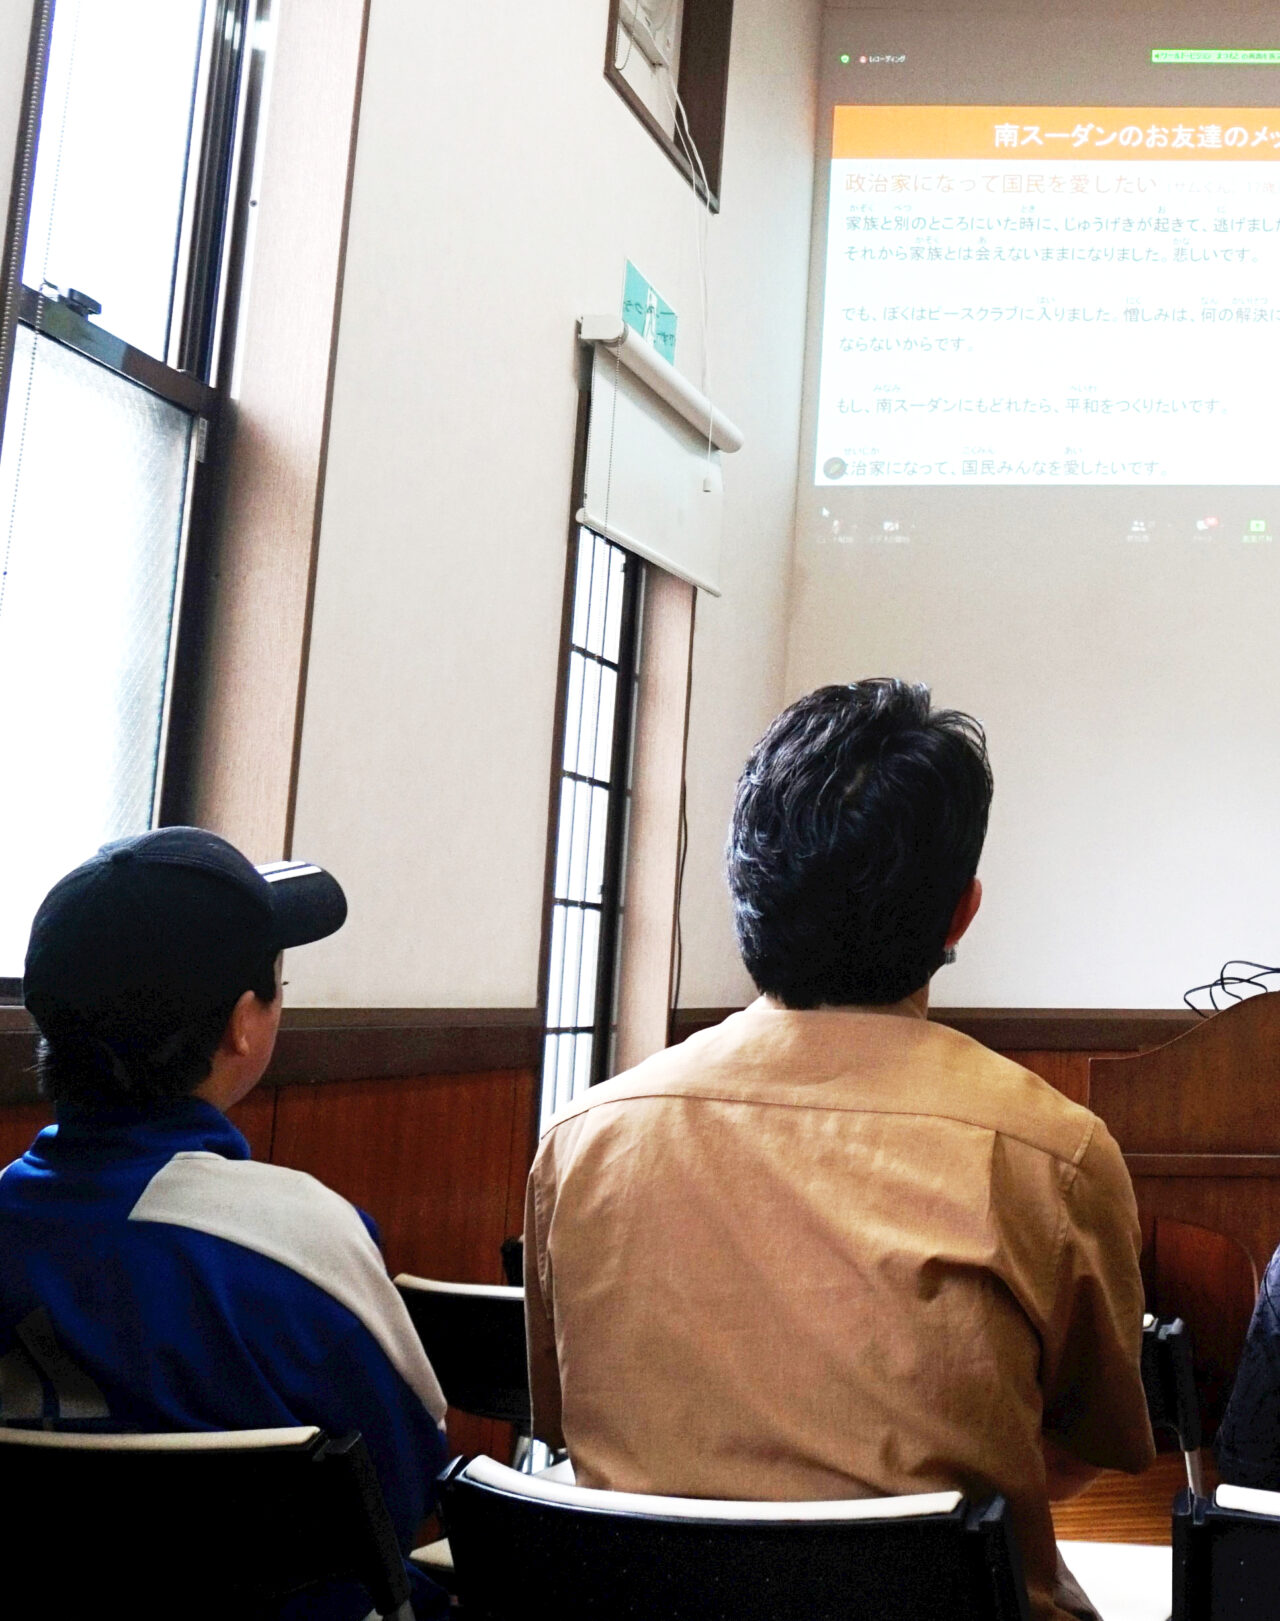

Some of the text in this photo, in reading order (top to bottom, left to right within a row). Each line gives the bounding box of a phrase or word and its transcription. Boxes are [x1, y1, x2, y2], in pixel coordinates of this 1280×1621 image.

[868, 54, 907, 63] レコーディング
[845, 174, 1157, 194] 政治家になって国民を愛したい
[845, 246, 1259, 262] それから家族とは会えないままになりました。悲しいです。
[839, 336, 975, 352] ならないからです。
[836, 398, 1228, 414] もし、南スーダンにもどれたら、平和をつくりたいです。
[842, 460, 1168, 476] 治家になって、国民みんなを愛したいです。
